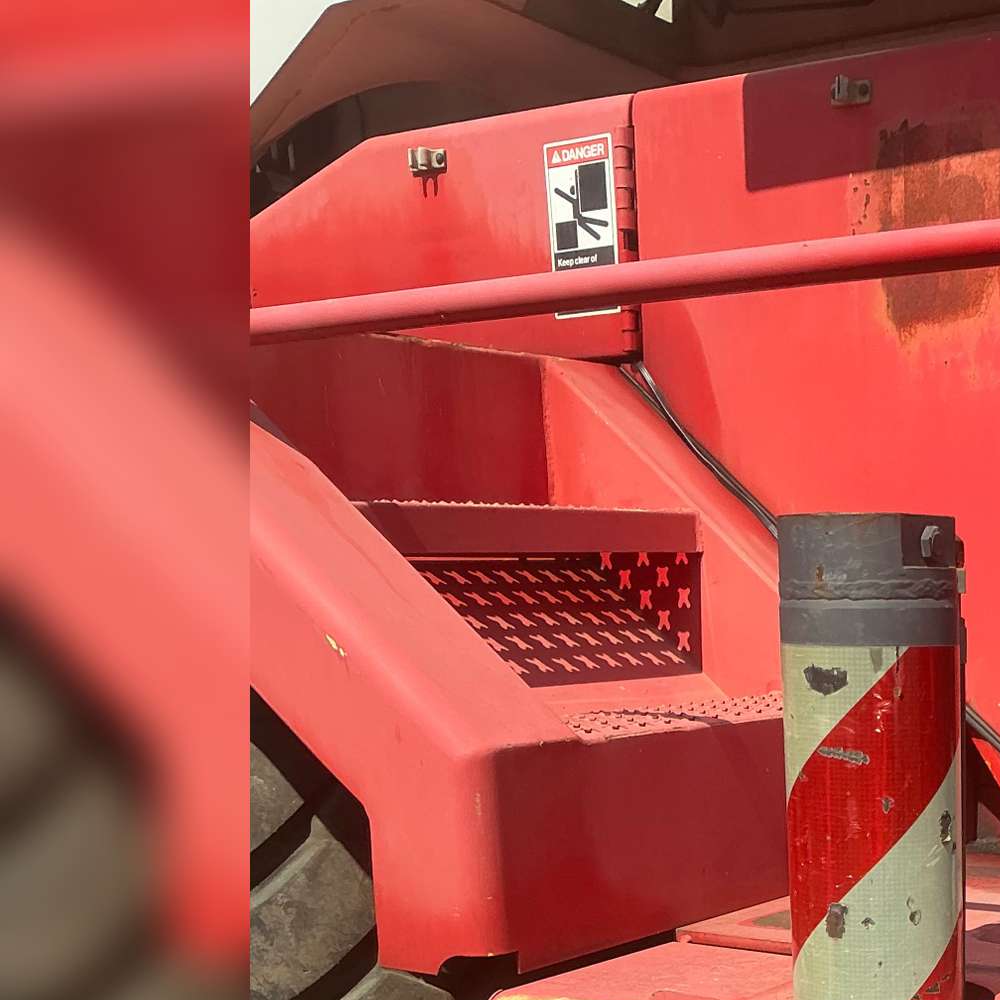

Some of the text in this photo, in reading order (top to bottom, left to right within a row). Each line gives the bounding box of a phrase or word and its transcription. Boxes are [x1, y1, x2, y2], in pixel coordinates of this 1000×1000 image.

[561, 143, 605, 162] DANGER
[558, 253, 598, 268] Keep clear of
